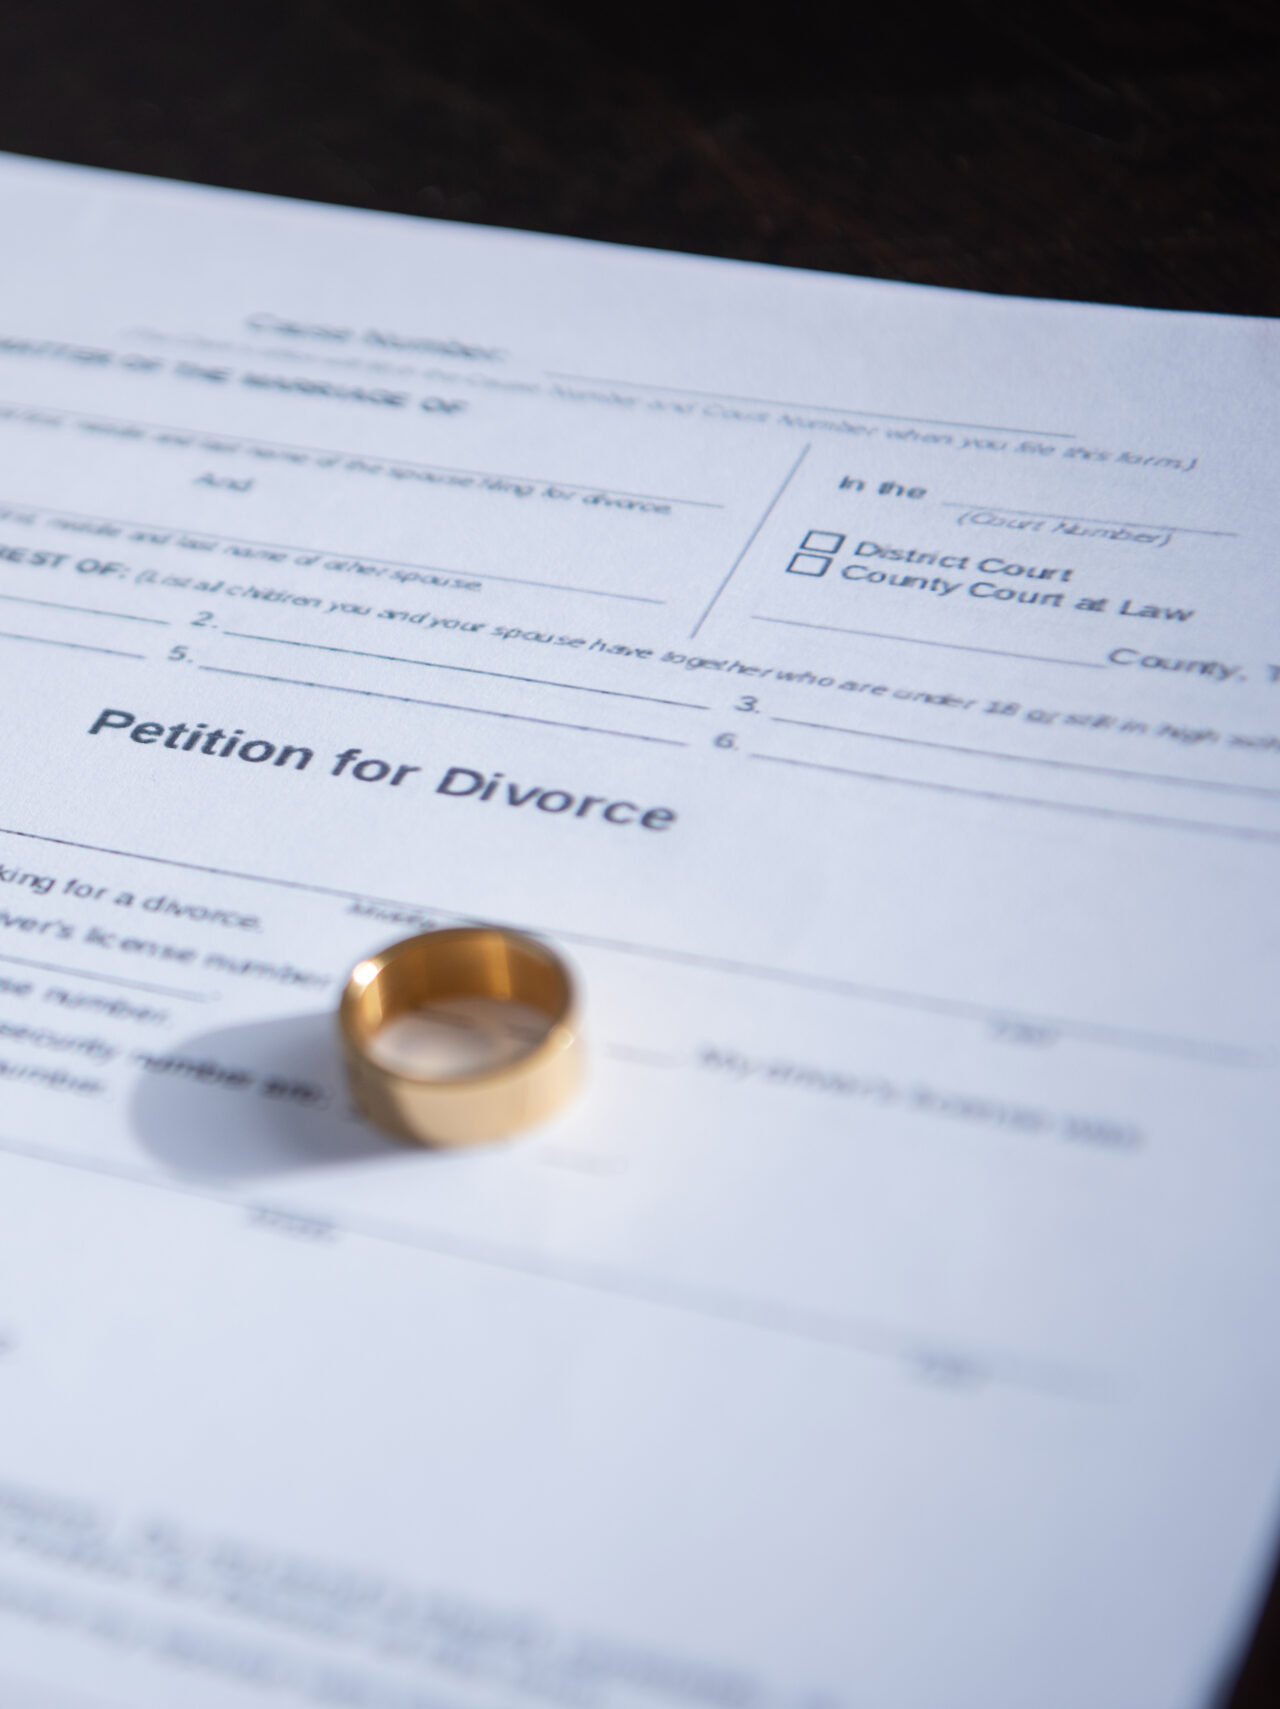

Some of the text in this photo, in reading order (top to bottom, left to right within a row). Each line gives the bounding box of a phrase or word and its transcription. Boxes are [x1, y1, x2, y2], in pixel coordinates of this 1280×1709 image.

[884, 425, 954, 447] when
[959, 435, 1007, 455] you
[1014, 439, 1056, 457] file
[1063, 446, 1108, 463] this
[387, 467, 476, 489] spouse
[541, 486, 578, 501] for
[837, 474, 928, 500] In the
[957, 510, 1174, 548] (Court Number)
[224, 544, 288, 565] name
[323, 557, 388, 578] other
[854, 540, 1074, 583] District Court
[840, 565, 1195, 623] County Court at Law
[74, 557, 132, 580] OF:
[224, 580, 321, 609] children
[326, 599, 372, 620] you
[376, 607, 427, 625] and
[427, 616, 485, 634] your
[489, 624, 587, 651] spouse
[588, 637, 655, 661] have
[660, 650, 774, 679] together
[775, 668, 835, 687] who
[837, 679, 889, 697] are
[891, 685, 975, 711] under
[189, 610, 220, 630] 2.
[167, 645, 195, 664] 5.
[733, 695, 763, 714] 3.
[712, 732, 740, 752] 6.
[87, 706, 680, 833] Petition for Divorce
[62, 878, 108, 902] for
[113, 890, 136, 908] a
[141, 894, 266, 934] divorce.
[83, 926, 200, 964] license
